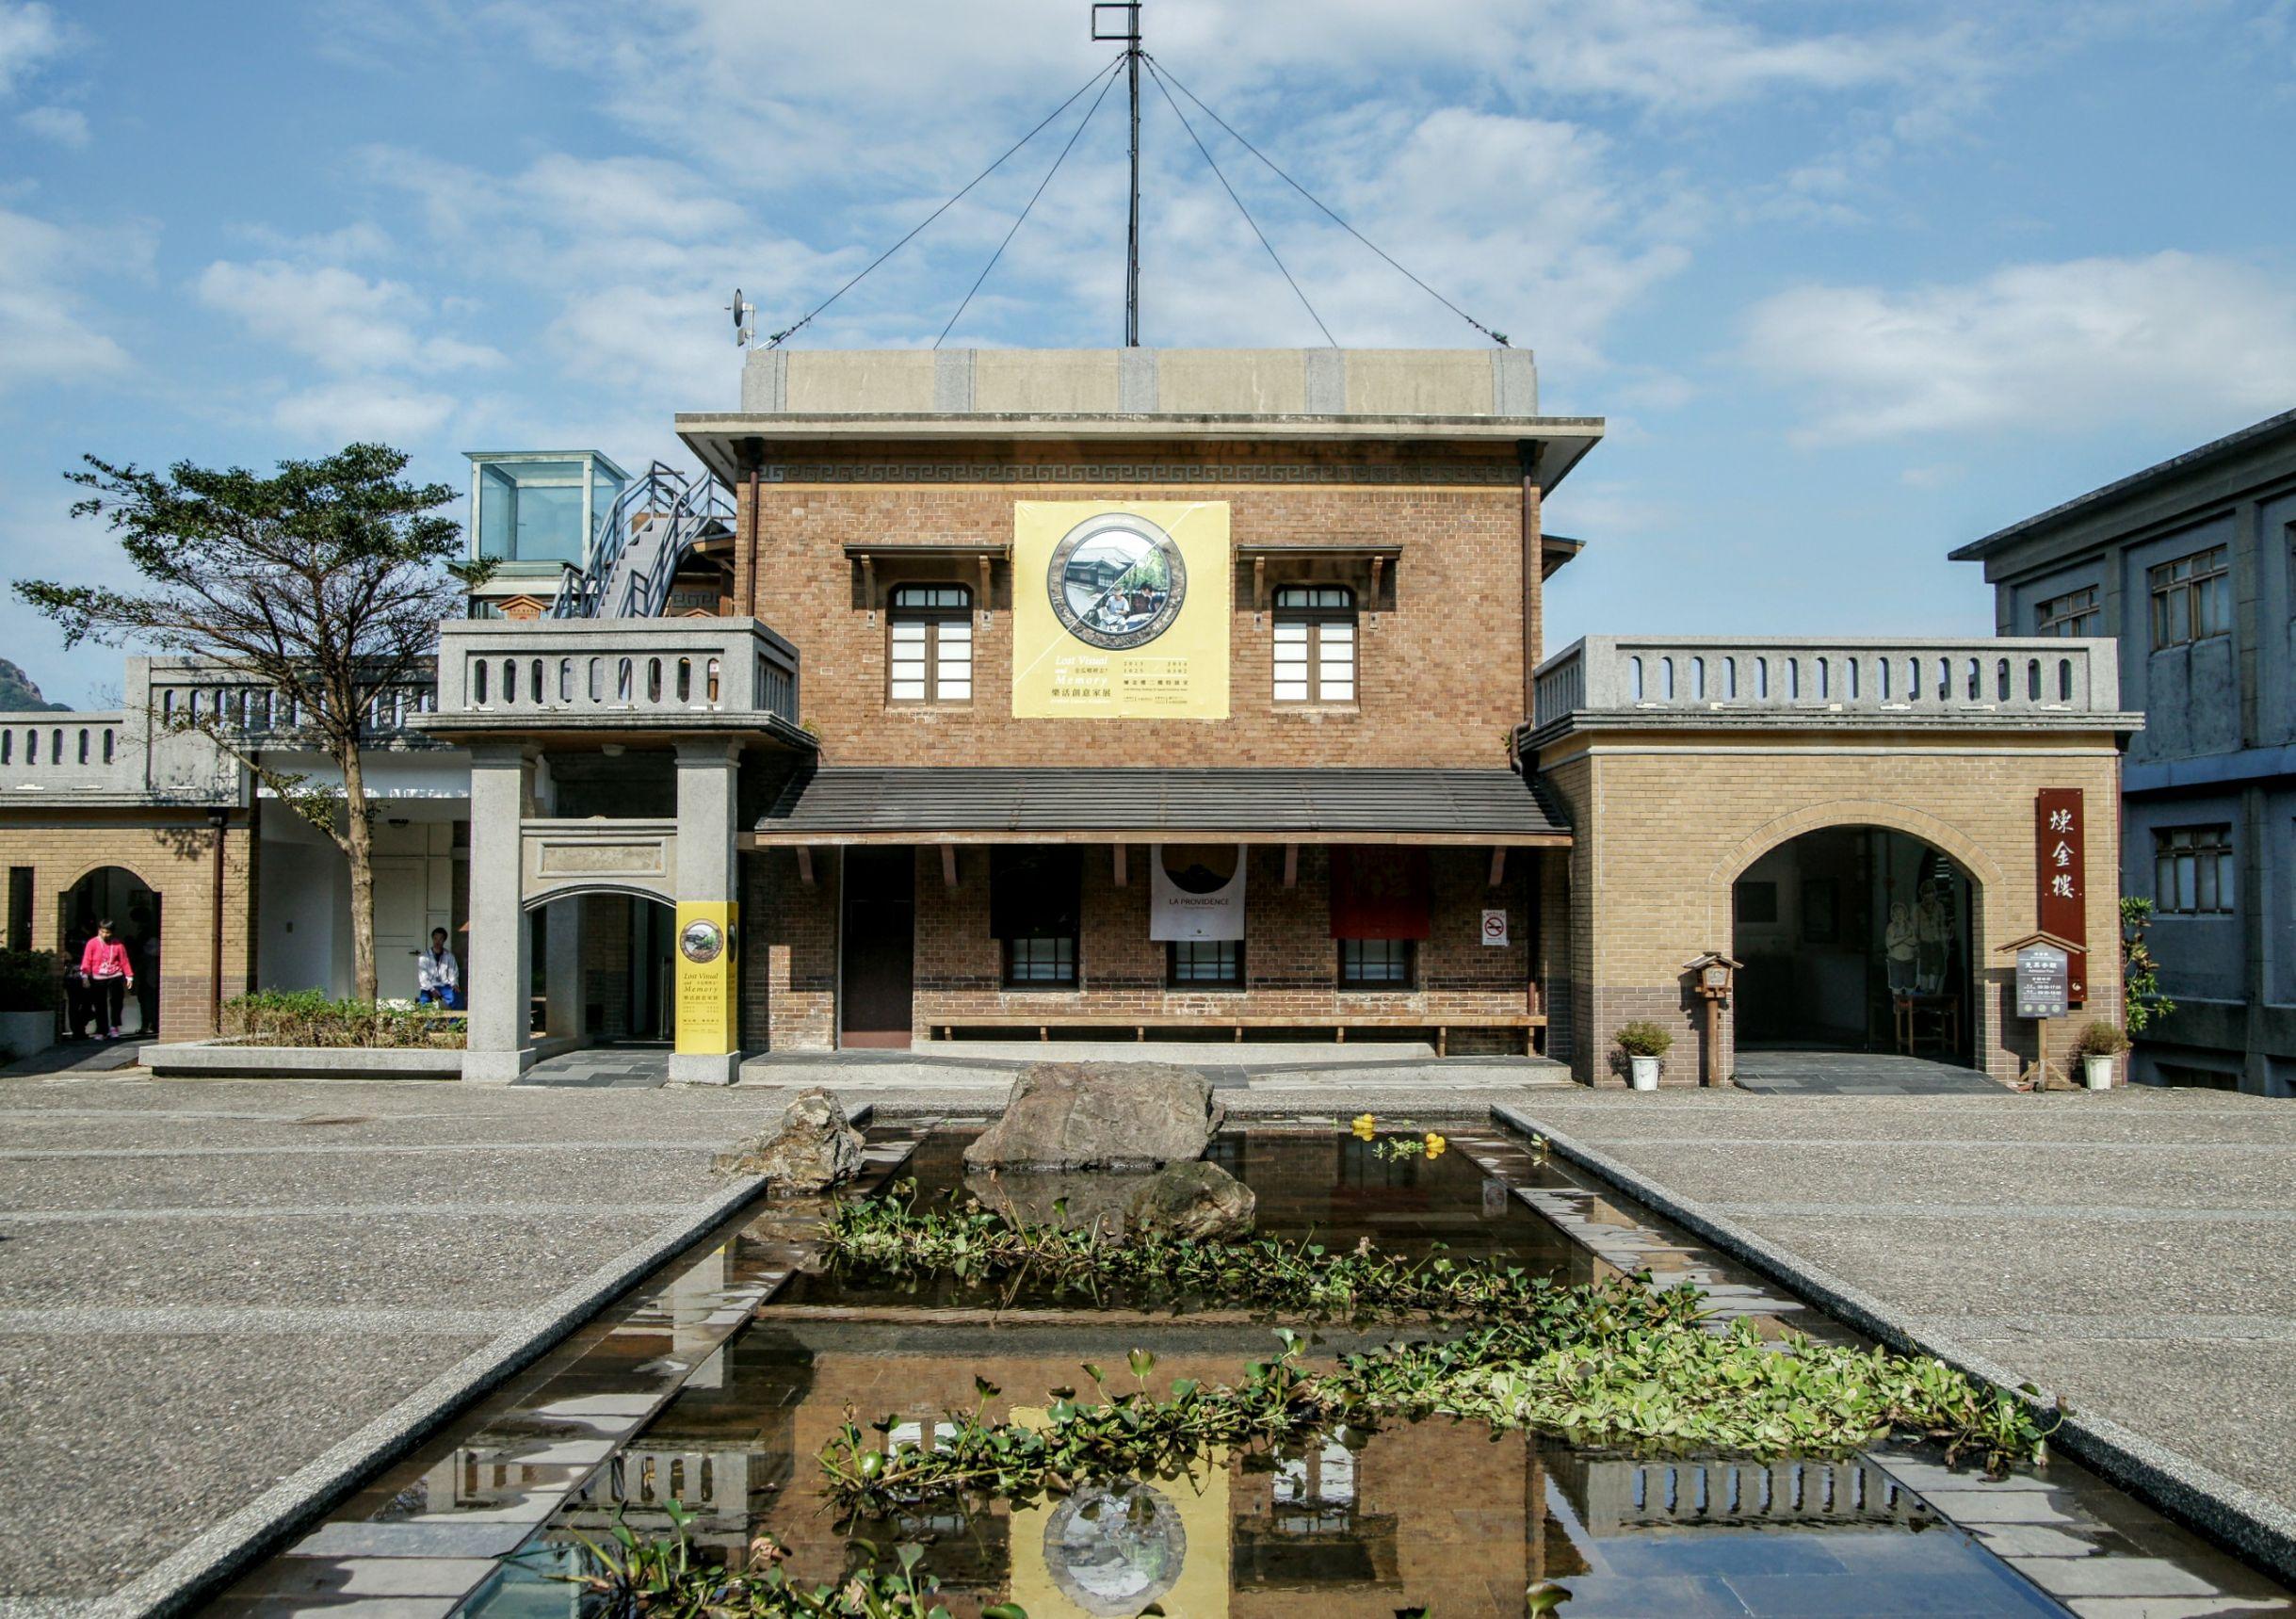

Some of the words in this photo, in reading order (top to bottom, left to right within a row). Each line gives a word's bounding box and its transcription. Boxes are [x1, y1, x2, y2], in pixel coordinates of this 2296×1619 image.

[1055, 656, 1075, 664] Lost
[1077, 656, 1108, 665] Visual
[1055, 675, 1108, 686] Memory
[2049, 808, 2075, 899] 煉金樓
